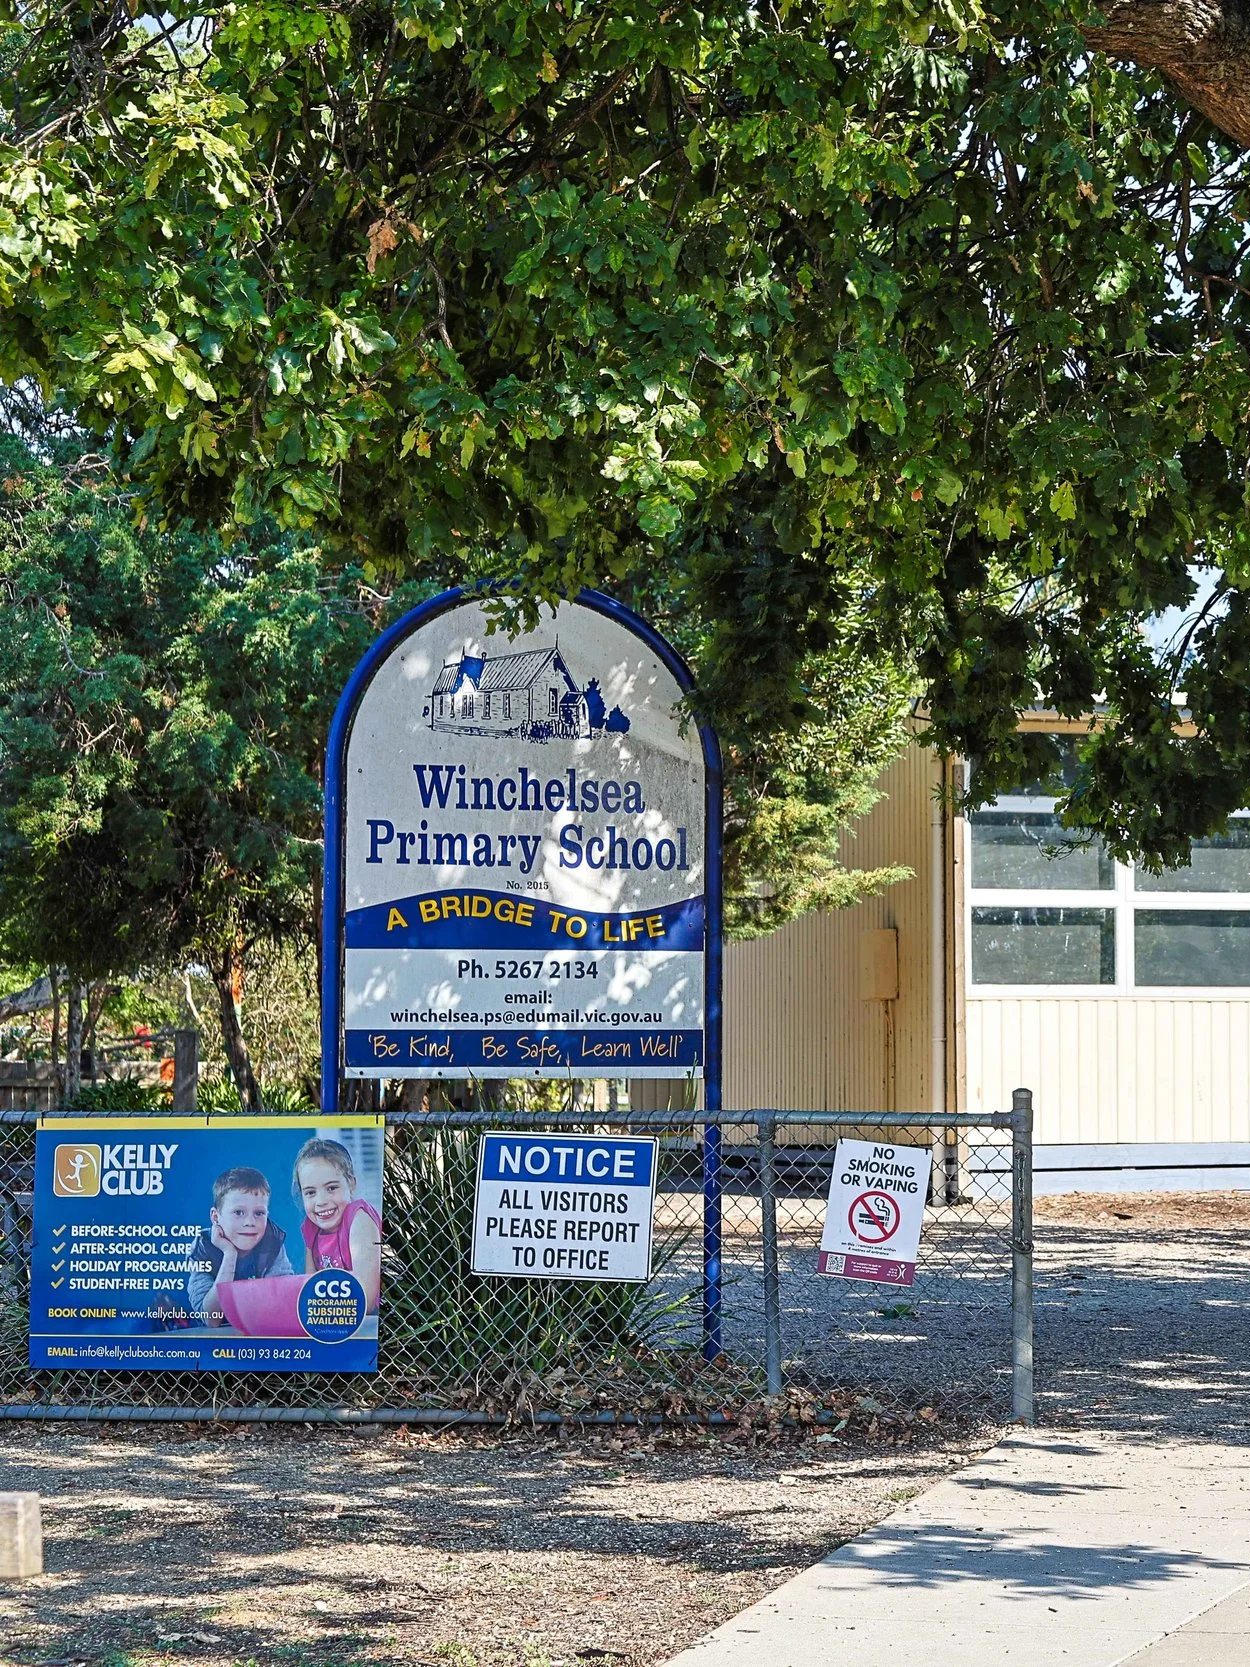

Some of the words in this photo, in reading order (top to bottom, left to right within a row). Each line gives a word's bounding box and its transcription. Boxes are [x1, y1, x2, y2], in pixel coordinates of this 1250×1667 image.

[413, 764, 646, 814] Winchelsea
[366, 819, 542, 874] Primary
[559, 823, 689, 871] School
[506, 880, 522, 890] No.
[527, 880, 549, 890] 2015
[387, 907, 408, 931] A
[419, 895, 535, 927] BRIDGE
[549, 910, 587, 938] TO
[603, 914, 666, 942] LIFE
[458, 959, 489, 979] Ph.
[495, 960, 543, 979] 5267
[550, 961, 598, 979] 2134
[504, 990, 552, 1004] email:
[390, 1009, 663, 1026] winchelsea.ps@edumail.vic.gov.au
[409, 1035, 454, 1063] Kind,
[482, 1036, 508, 1057] Be
[517, 1036, 562, 1065] Safe,
[581, 1036, 631, 1058] Learn
[103, 1144, 179, 1169] KELLY
[499, 1145, 636, 1178] NOTICE
[873, 1146, 895, 1160] NO
[848, 1159, 915, 1178] SMOKING
[101, 1170, 164, 1196] CLUB
[840, 1173, 860, 1186] OR
[865, 1176, 918, 1193] VAPING
[499, 1189, 533, 1210] ALL
[541, 1190, 628, 1214] VISITORS
[71, 1225, 167, 1237] BEFORE-SCHOOL
[171, 1225, 201, 1237] CARE
[486, 1217, 557, 1239] PLEASE
[564, 1220, 640, 1243] REPORT
[70, 1243, 158, 1255] AFTER-SCHOOL
[161, 1243, 192, 1255] CARE
[512, 1246, 536, 1267] TO
[543, 1248, 609, 1270] OFFICE
[69, 1260, 121, 1272] HOLIDAY
[125, 1261, 212, 1273] PROGRAMMES
[69, 1278, 149, 1290] STUDENT-FREE
[153, 1278, 184, 1290] DAYS
[314, 1280, 351, 1298] CCS
[48, 1308, 77, 1318] BOOK
[80, 1308, 116, 1318] ONLINE
[121, 1307, 224, 1321] www.kellyclub.com.au
[307, 1307, 357, 1317] SUBSIDIES
[307, 1317, 357, 1325] AVAILABLE!
[47, 1347, 78, 1357] EMAIL:
[79, 1345, 200, 1360] info@kellycluboshc.com.au
[213, 1349, 236, 1358] CALL
[238, 1349, 256, 1360] (03)
[259, 1350, 270, 1359] 93
[274, 1350, 290, 1359] 842
[293, 1350, 311, 1359] 204
